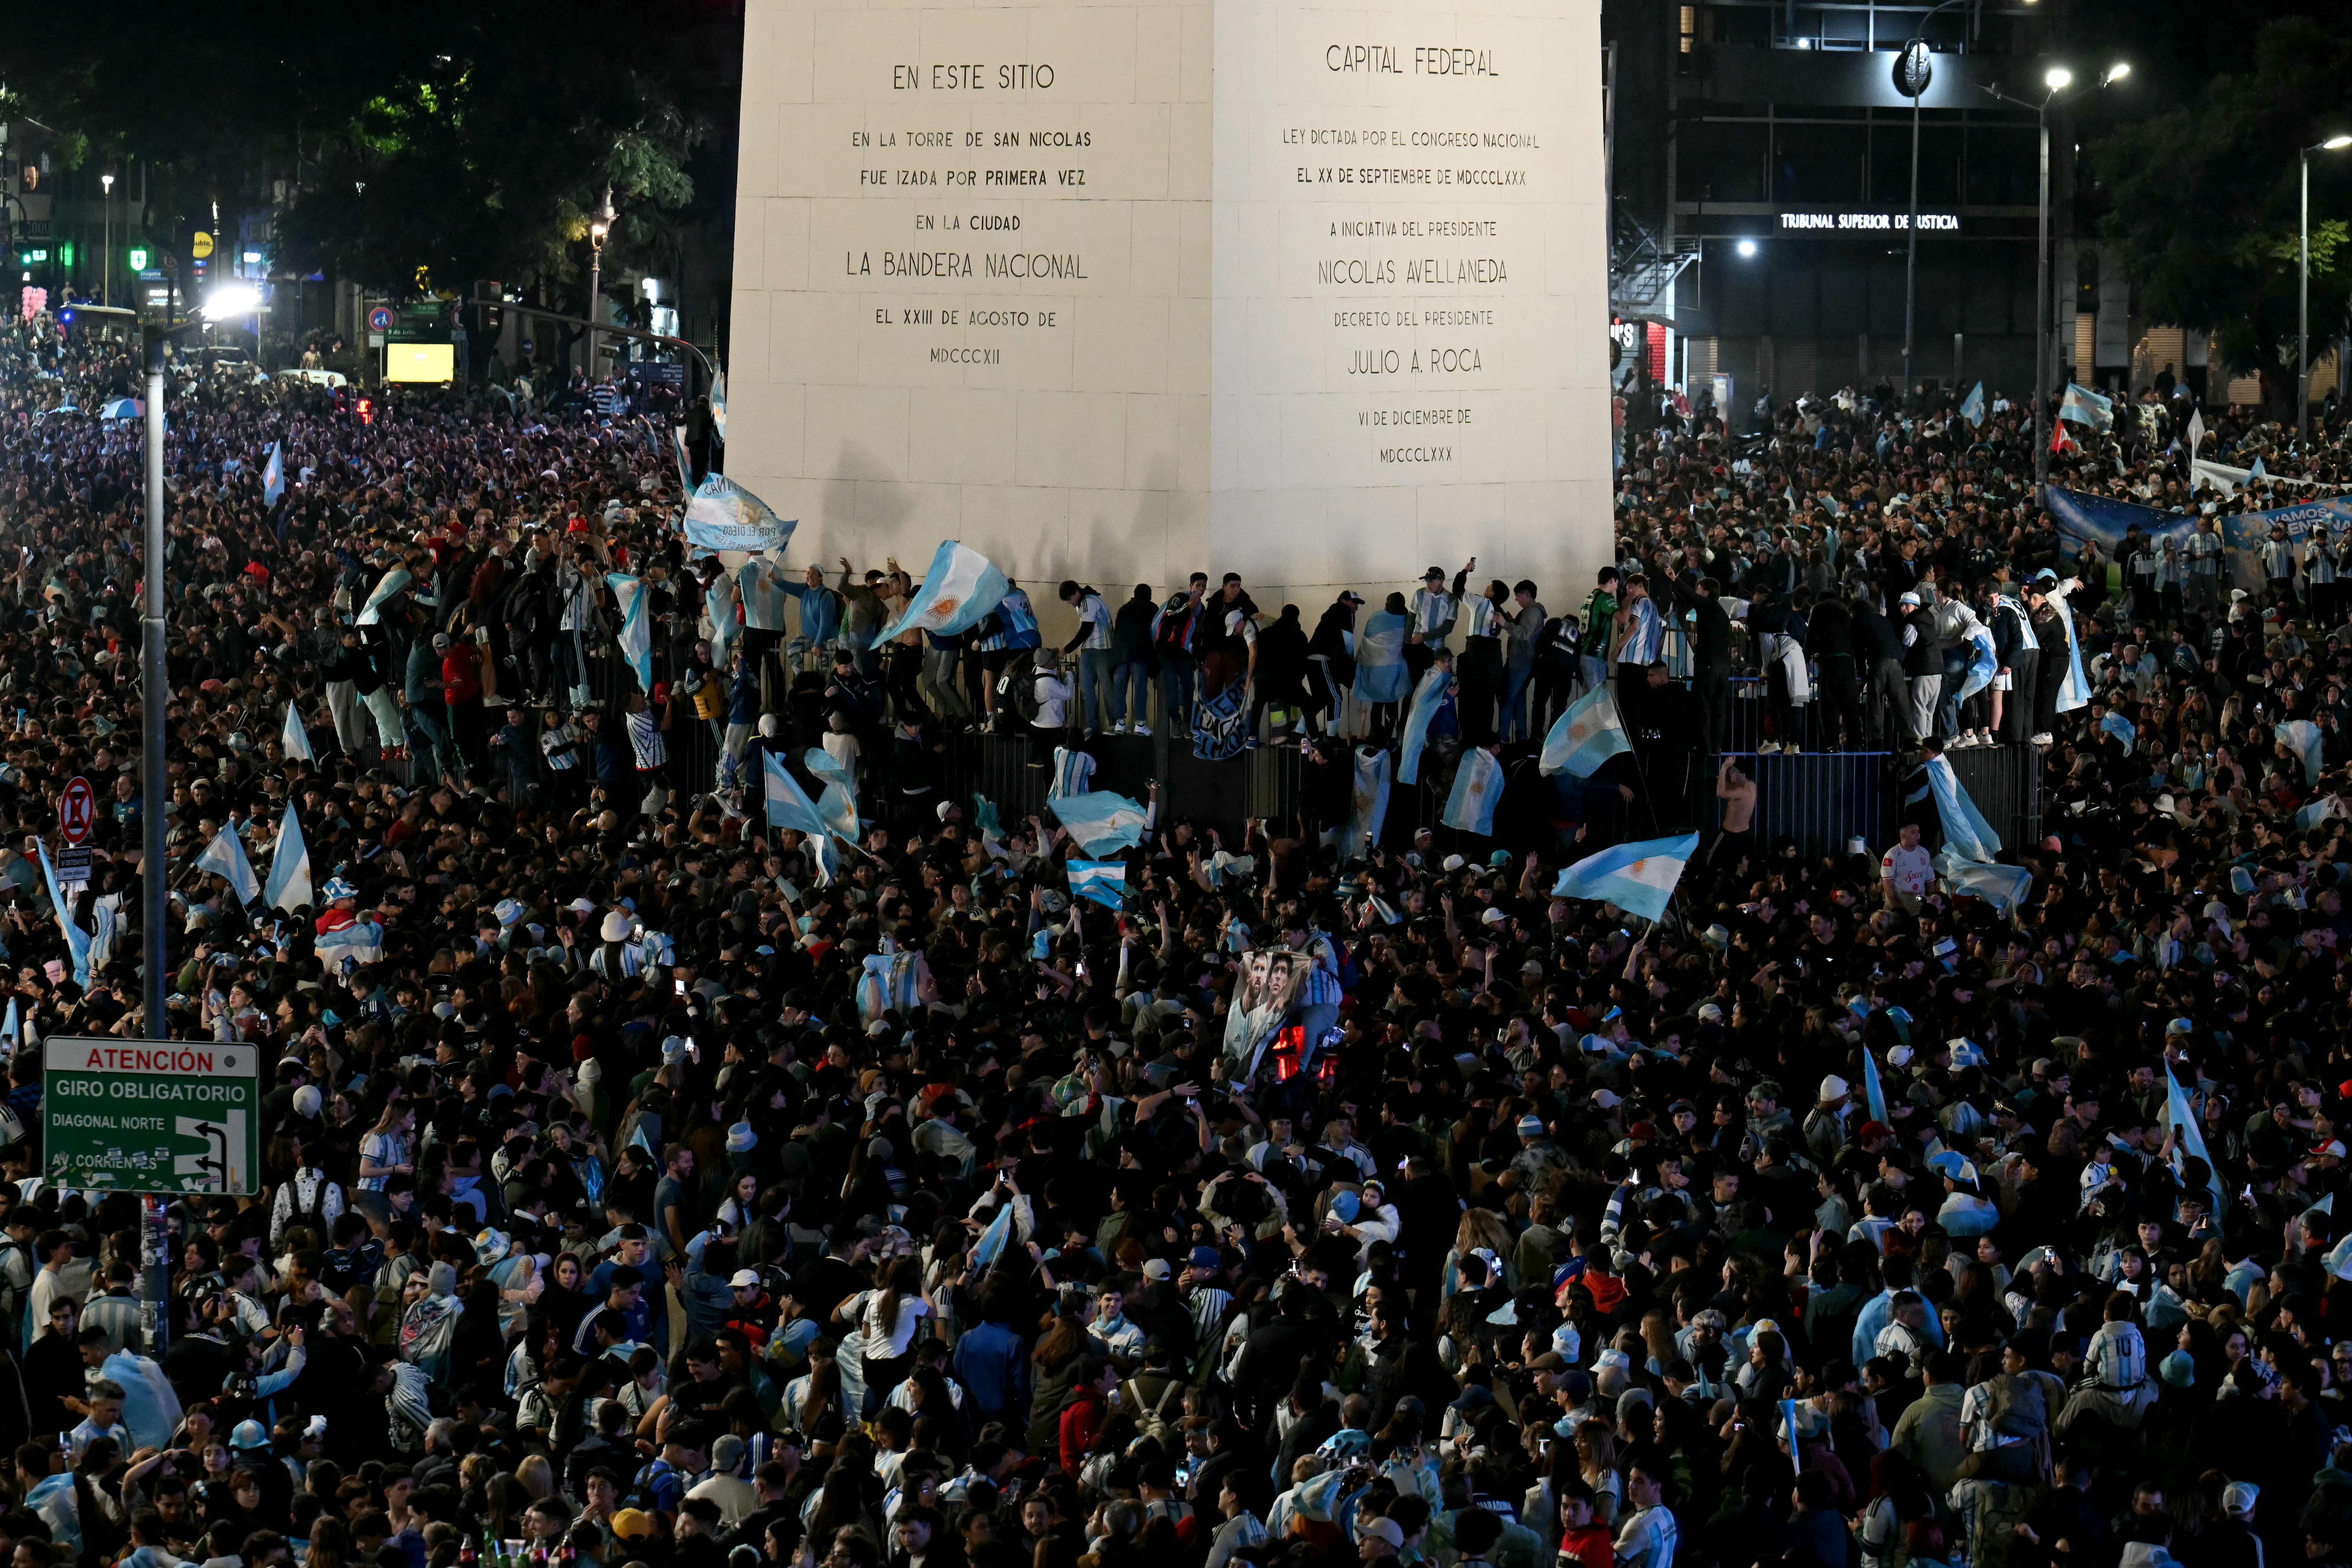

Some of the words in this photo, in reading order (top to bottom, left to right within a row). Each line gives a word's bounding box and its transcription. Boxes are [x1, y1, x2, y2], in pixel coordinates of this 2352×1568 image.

[1327, 45, 1403, 73] CAPITAL
[1416, 48, 1499, 76] FEDERAL
[894, 65, 918, 89] EN
[933, 65, 984, 89] ESTE
[999, 64, 1054, 89] SITIO
[853, 132, 869, 146] EN
[881, 133, 896, 147] LA
[907, 132, 953, 147] TORRE
[966, 132, 983, 146] DE
[994, 132, 1019, 147] SAN
[1030, 132, 1090, 147] NICOLAS
[1284, 129, 1305, 143] LEY
[1311, 129, 1357, 144] DICTADA
[1363, 131, 1386, 145] POR
[1392, 132, 1406, 145] EL
[1412, 132, 1478, 147] CONGRESO
[1484, 133, 1539, 148] NACIONAL
[861, 170, 887, 185] FUE
[897, 170, 937, 185] IZADA
[947, 171, 976, 186] POR
[986, 170, 1046, 185] PRIMERA
[1058, 170, 1085, 185] VEZ
[1298, 168, 1312, 183] EL
[1319, 168, 1332, 183] XX
[1339, 168, 1353, 183] DE
[1360, 168, 1431, 183] SEPTIEMBRE
[1438, 169, 1451, 184] DE
[1457, 170, 1526, 185] MDCCCLXXX
[917, 215, 933, 230] EN
[944, 215, 960, 230] LA
[970, 215, 1020, 231] CIUDAD
[1331, 222, 1336, 236] A
[1343, 222, 1396, 237] INICIATIVA
[1403, 222, 1423, 236] DEL
[1429, 222, 1496, 236] PRESIDENTE
[1781, 214, 1835, 229] TRIBUNAL
[1838, 214, 1890, 229] SUPERIOR
[1895, 215, 1909, 229] DE
[1915, 215, 1959, 229] USTICIA
[847, 252, 870, 275] LA
[884, 252, 972, 277] BANDERA
[986, 254, 1088, 279] NACIONAL
[1319, 260, 1395, 284] NICOLAS
[1407, 259, 1507, 284] AVELLANEDA
[876, 309, 892, 324] EL
[904, 310, 932, 324] XXIII
[942, 310, 959, 325] DE
[969, 311, 1028, 326] AGOSTO
[1039, 312, 1056, 327] DE
[1335, 312, 1390, 326] DECRETO
[1397, 312, 1418, 326] DEL
[1425, 311, 1493, 325] PRESIDENTE
[931, 348, 999, 364] MDCCCXII
[1348, 350, 1399, 374] JULIO
[1411, 349, 1422, 373] A.
[1431, 349, 1481, 373] ROCA
[1359, 412, 1367, 425] VI
[1374, 412, 1387, 425] DE
[1393, 410, 1453, 425] DICIEMBRE
[1458, 409, 1471, 423] DE
[1381, 447, 1451, 463] MDCCCLXXX
[2266, 508, 2328, 529] VAMOS
[1558, 621, 1578, 643] 10
[1906, 868, 1924, 883] Secco
[87, 1047, 213, 1072] ATENCIÓN
[56, 1080, 104, 1098] GIRO
[110, 1082, 246, 1102] OBLIGATORIO
[52, 1114, 118, 1129] DIAGONAL
[121, 1116, 165, 1130] NORTE
[2115, 1335, 2132, 1357] 10
